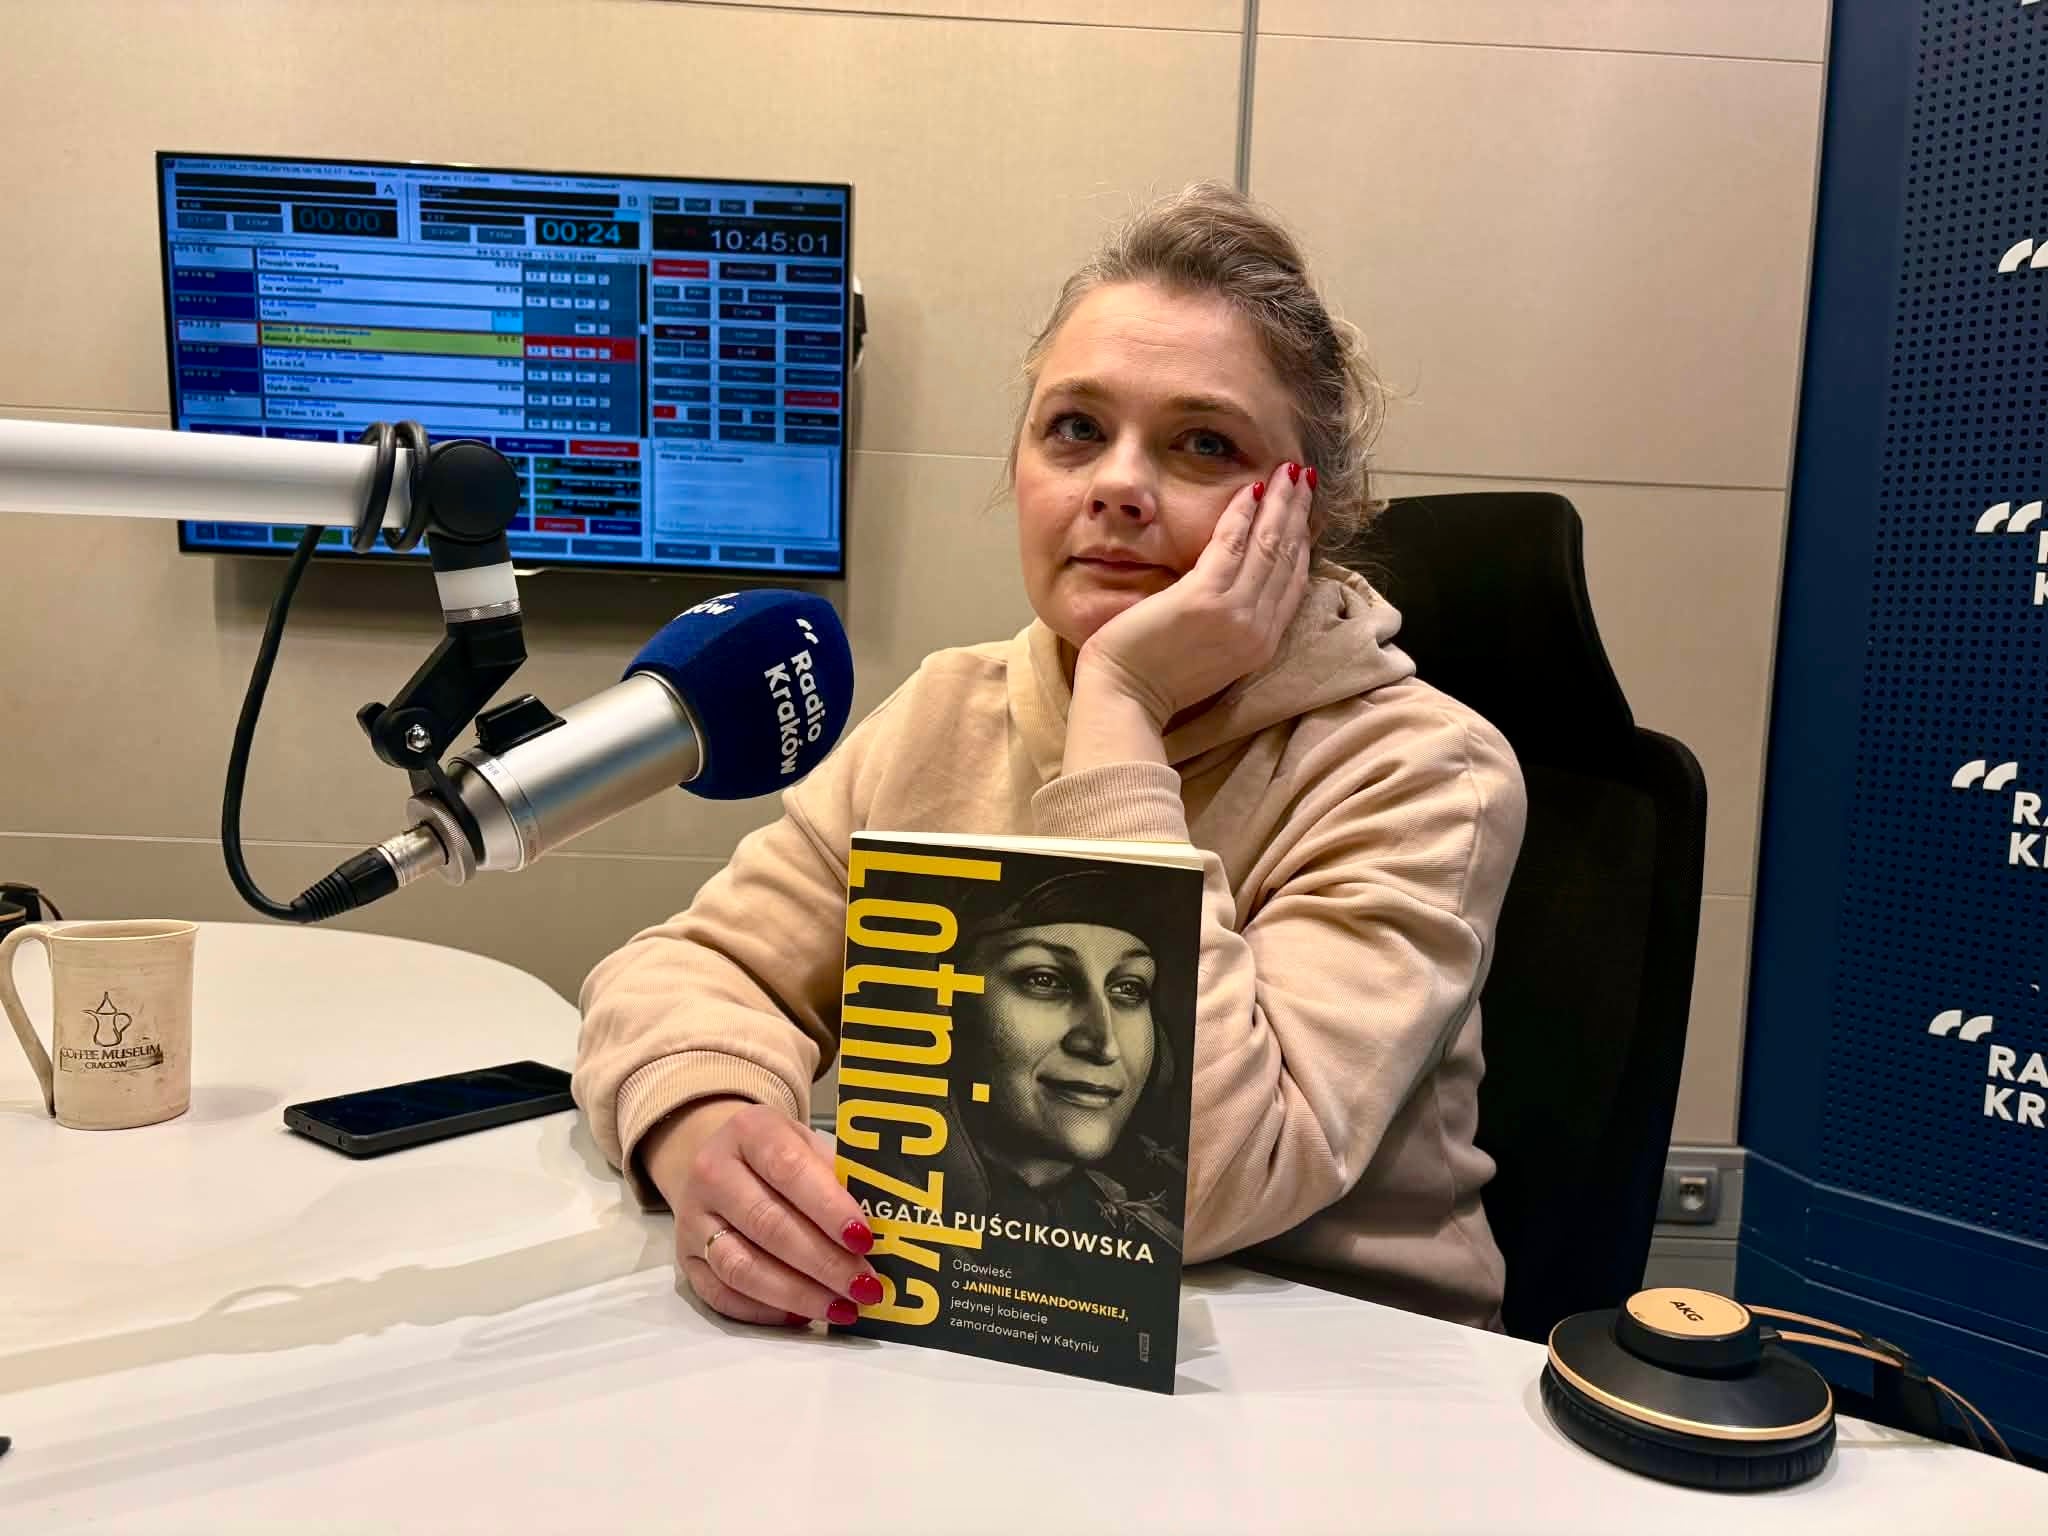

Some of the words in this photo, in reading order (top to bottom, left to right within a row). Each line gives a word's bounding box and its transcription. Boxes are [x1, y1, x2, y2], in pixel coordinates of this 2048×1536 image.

[384, 184, 395, 196] A
[300, 207, 381, 233] 00:00
[541, 221, 622, 244] 00:24
[711, 229, 829, 254] 10:45:01
[790, 649, 826, 742] Radio
[764, 662, 804, 774] Kraków
[101, 1043, 160, 1060] MUSEUM
[84, 1060, 128, 1069] CRACOW
[860, 1199, 944, 1228] AGATA
[954, 1210, 1155, 1264] PUŚCIKOWSKA
[952, 1260, 1013, 1279] Opowieść
[949, 1297, 995, 1316] jedynej
[997, 1305, 1048, 1324] kobiecie
[951, 1281, 960, 1289] o
[962, 1280, 1012, 1298] JANINIE
[1014, 1290, 1129, 1323] LEWANDOWSKIEJ,
[1669, 1301, 1704, 1321] AKG
[949, 1318, 1038, 1344] zamordowanej
[1041, 1335, 1051, 1344] w
[1054, 1335, 1100, 1354] Katyniu
